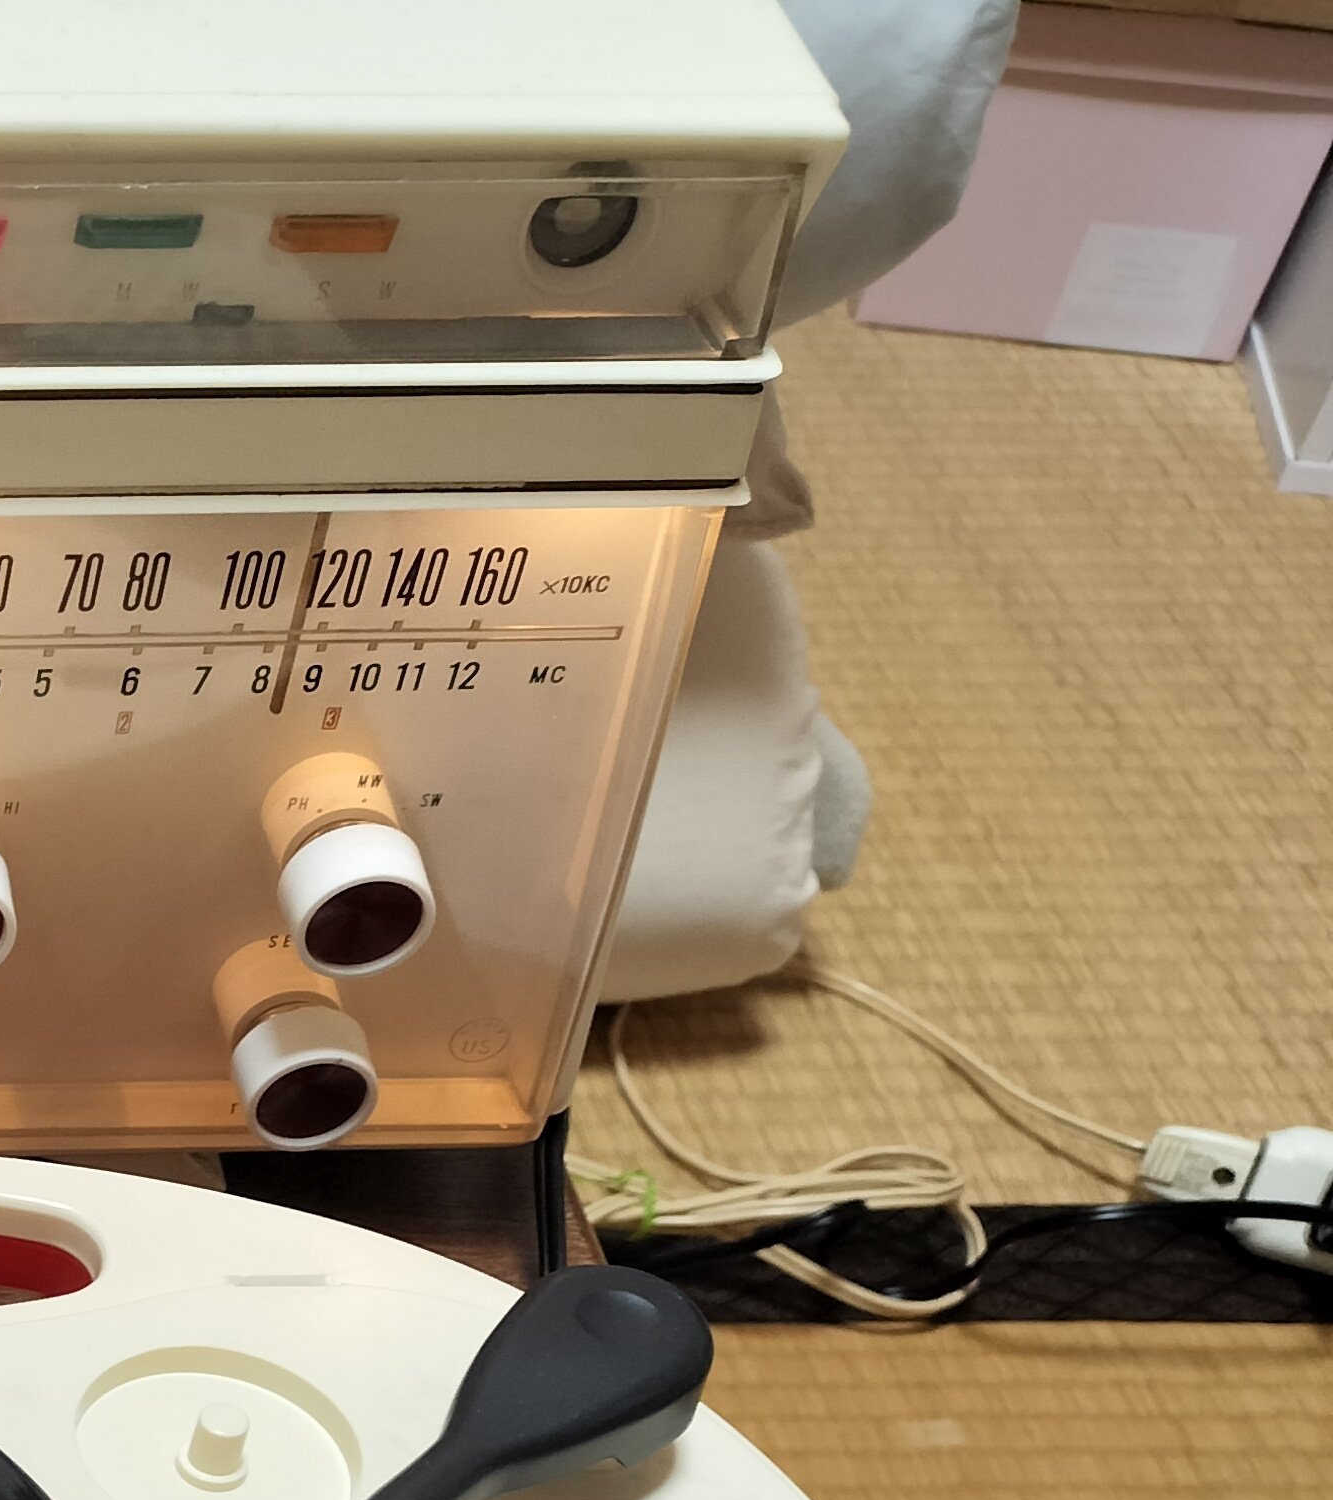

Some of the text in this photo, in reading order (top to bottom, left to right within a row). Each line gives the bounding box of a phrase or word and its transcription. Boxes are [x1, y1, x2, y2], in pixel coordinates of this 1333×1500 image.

[58, 553, 104, 613] 70
[123, 552, 171, 612] 80
[220, 550, 286, 610] 100
[306, 548, 372, 609] 120
[381, 547, 449, 607] 140
[460, 547, 529, 606] 160
[34, 668, 53, 697] 5
[121, 667, 141, 696] 6
[192, 666, 212, 695] 7
[251, 664, 270, 693] 8
[302, 664, 323, 692] 9
[349, 663, 381, 692] 10
[396, 662, 427, 692] 11
[447, 661, 481, 691] 12
[529, 665, 566, 685] MC
[3, 801, 20, 815] HI
[286, 797, 309, 811] PH
